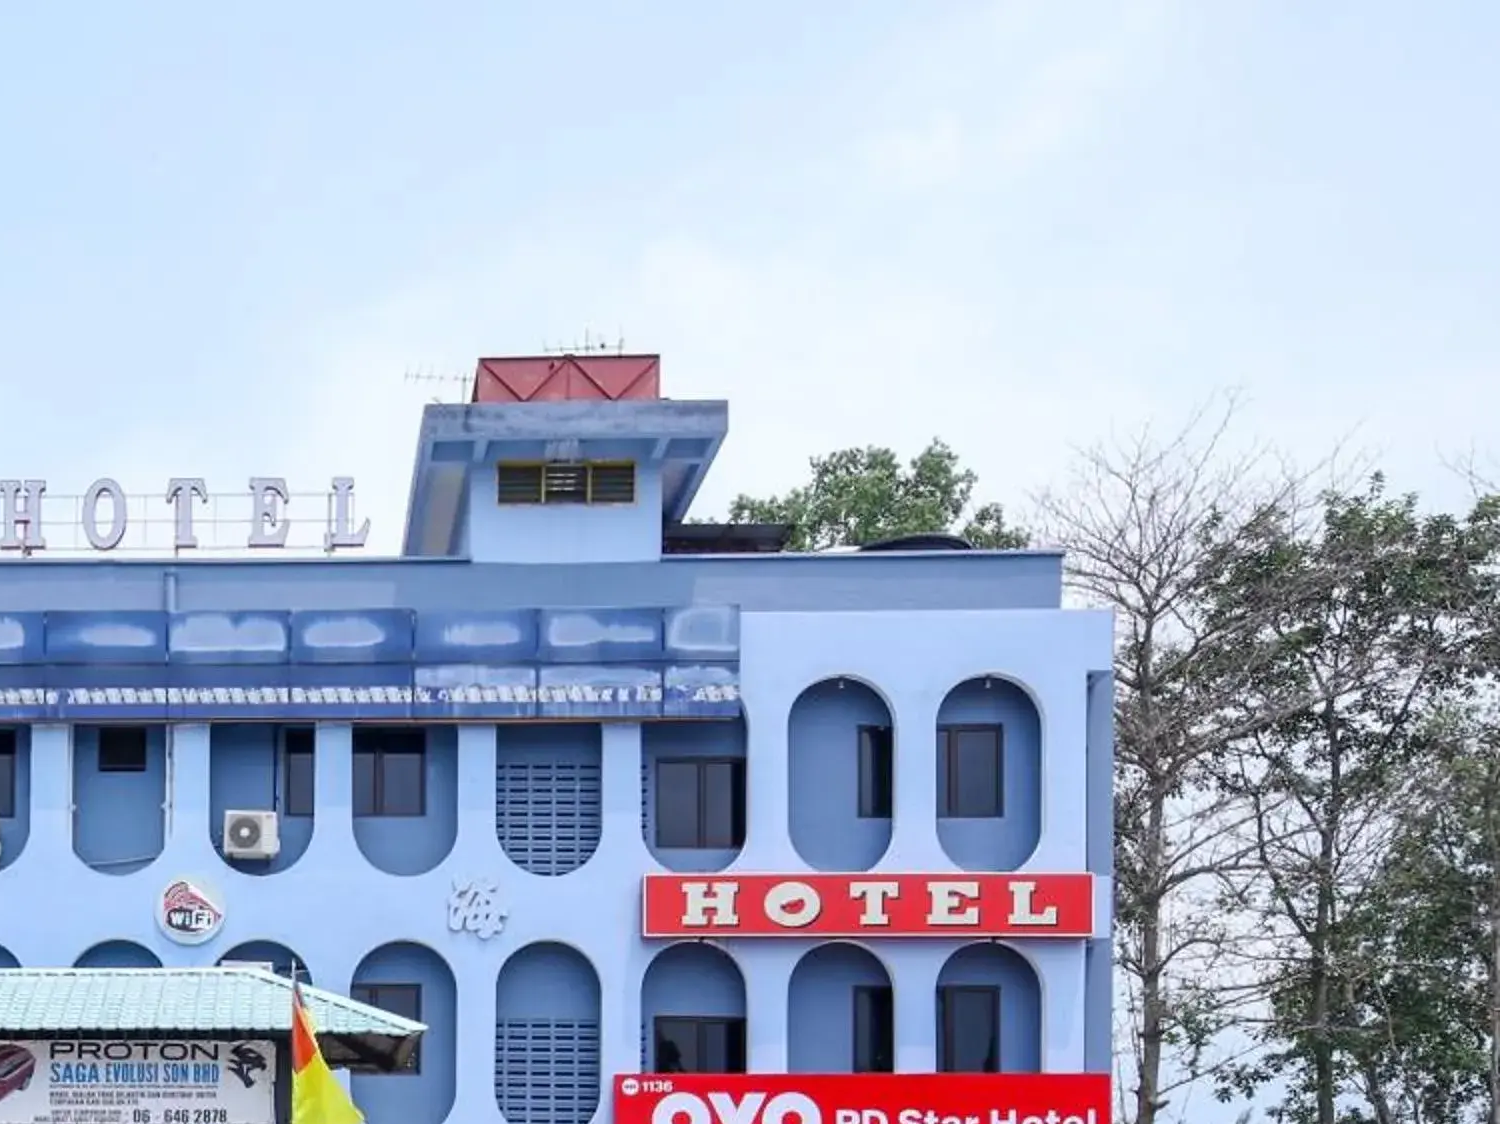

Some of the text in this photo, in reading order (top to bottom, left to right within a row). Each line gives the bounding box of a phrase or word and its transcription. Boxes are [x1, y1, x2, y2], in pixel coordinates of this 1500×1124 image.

[681, 881, 1057, 927] HOTEL
[50, 1042, 219, 1061] PROTON
[50, 1062, 101, 1083] SAGA
[105, 1062, 159, 1083] EVOLUSI
[193, 1062, 220, 1083] BHD
[642, 1080, 673, 1093] 1136
[133, 1109, 151, 1124] 06
[164, 1109, 189, 1124] 646
[194, 1109, 228, 1124] 2878
